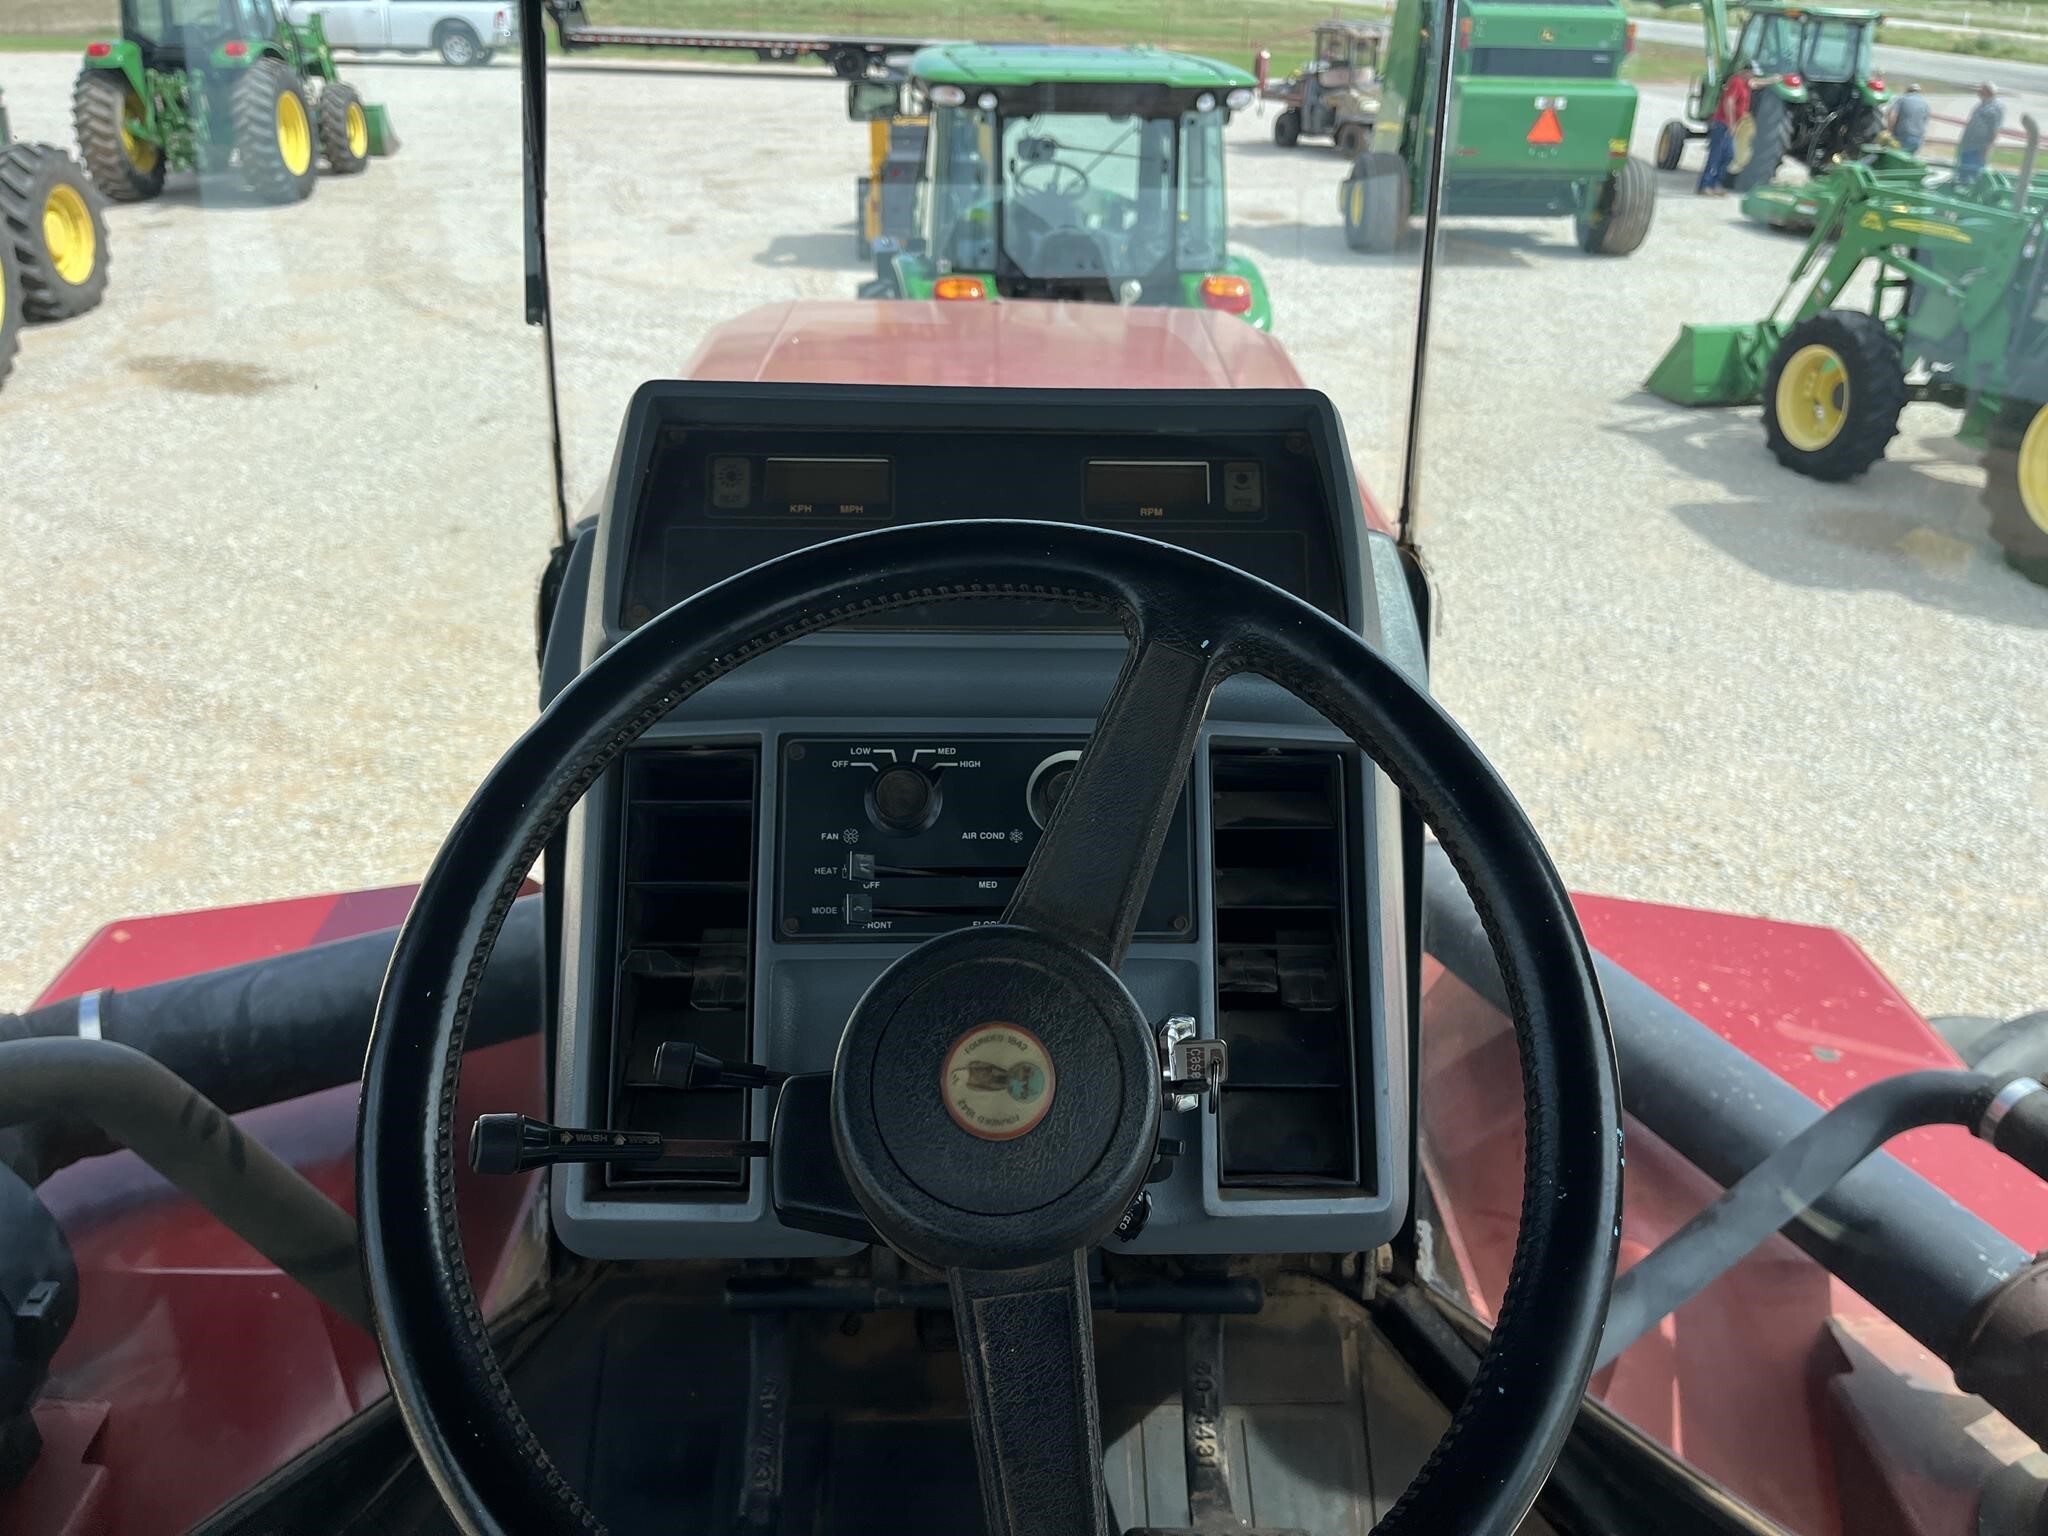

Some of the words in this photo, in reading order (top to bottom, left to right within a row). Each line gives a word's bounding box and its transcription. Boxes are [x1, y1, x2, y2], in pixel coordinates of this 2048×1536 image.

[789, 504, 813, 513] KPH
[839, 505, 864, 513] MPH
[1140, 507, 1163, 517] RPM
[850, 747, 871, 756] LOW
[937, 747, 957, 756] MED
[831, 760, 849, 768] OFF
[959, 760, 981, 768] HIGH
[821, 832, 839, 841] FAN
[961, 831, 977, 840] AIR
[979, 831, 1006, 841] COND
[814, 867, 838, 876] HEAT
[863, 881, 881, 890] OFF
[978, 880, 998, 889] MED
[811, 906, 838, 915] MODE
[862, 920, 893, 930] RONT
[1008, 1035, 1028, 1052] 1842
[575, 1133, 608, 1143] WASH
